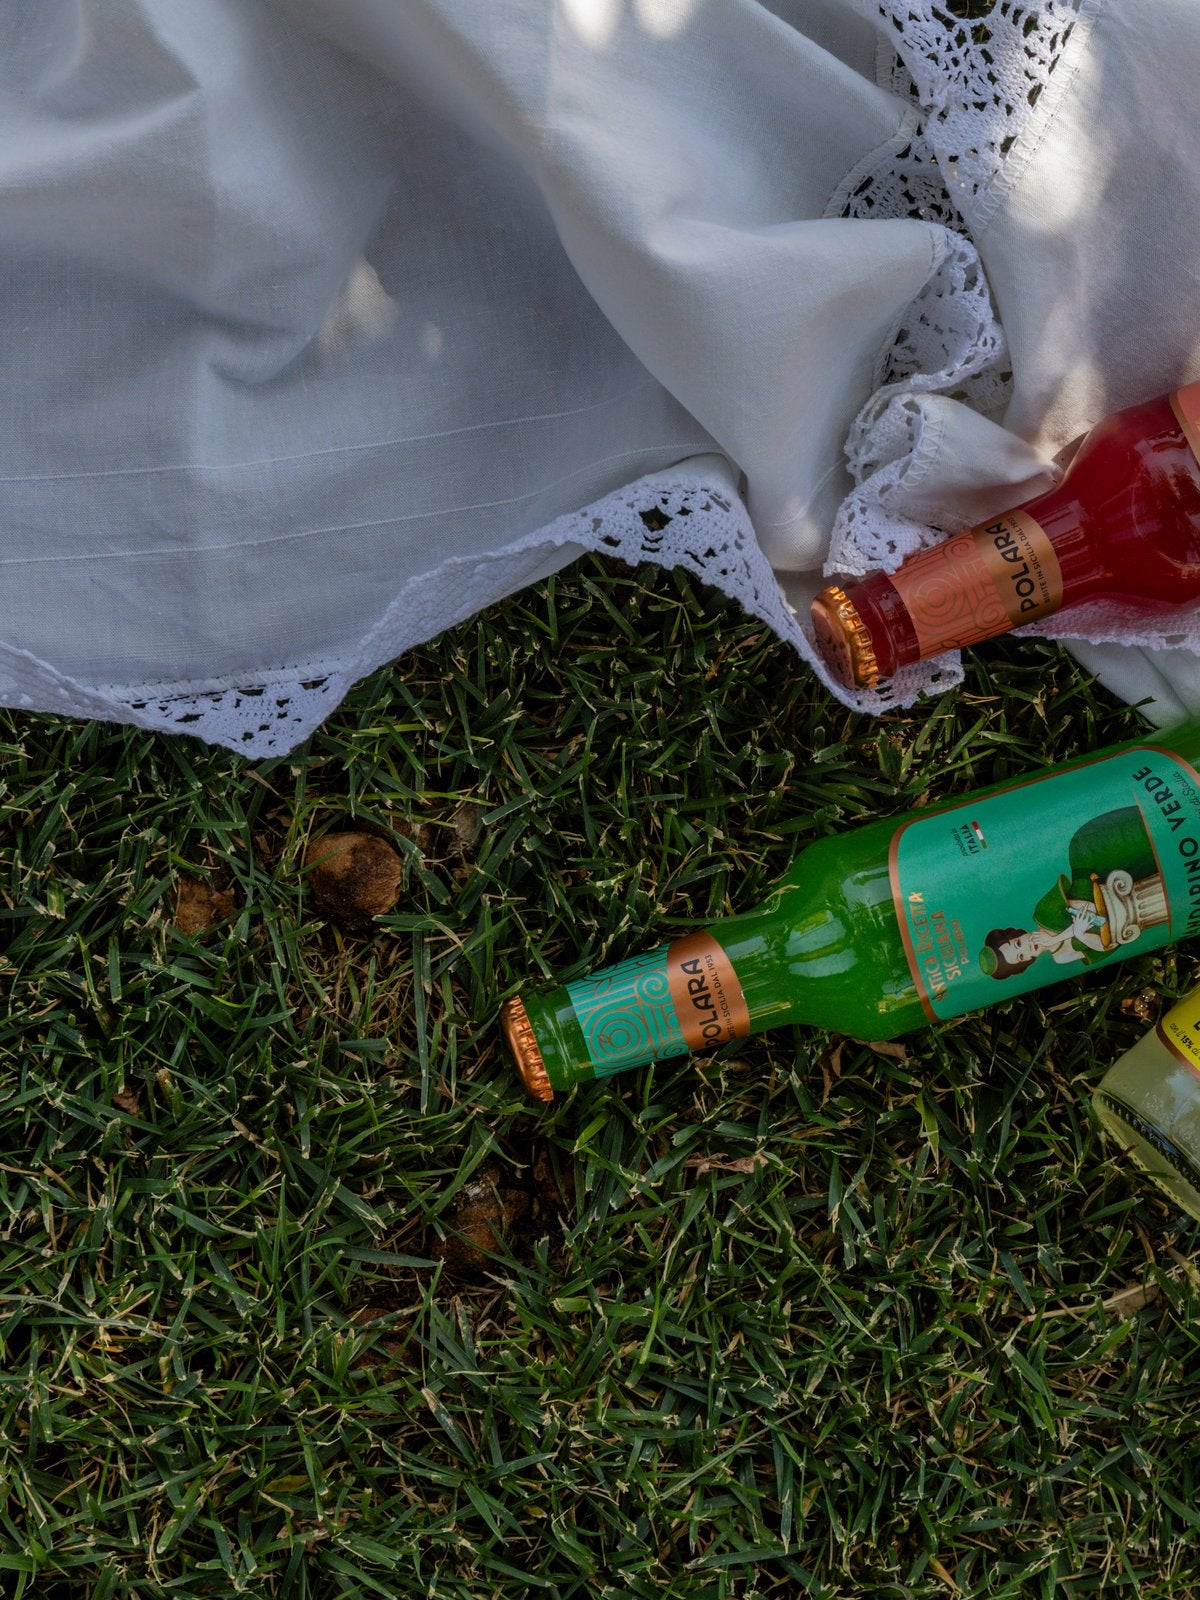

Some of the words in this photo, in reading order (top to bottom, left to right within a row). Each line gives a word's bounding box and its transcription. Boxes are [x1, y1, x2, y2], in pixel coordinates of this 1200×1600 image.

[1016, 528, 1028, 542] DAL
[984, 522, 1040, 612] POLARA
[1025, 542, 1040, 570] SICILIA
[1173, 771, 1196, 797] Sicilia
[1132, 766, 1188, 832] VERDE
[1189, 796, 1200, 806] di
[960, 824, 980, 854] ITALIA
[908, 892, 934, 954] RICETTA
[930, 910, 962, 982] SICILIANA
[952, 918, 971, 966] POLARA
[704, 955, 716, 972] 1953
[922, 954, 948, 1002] ANTICA
[712, 972, 722, 988] DAL
[718, 989, 730, 1018] SICILIA
[1180, 1035, 1194, 1049] 15%
[1192, 1047, 1200, 1057] di
